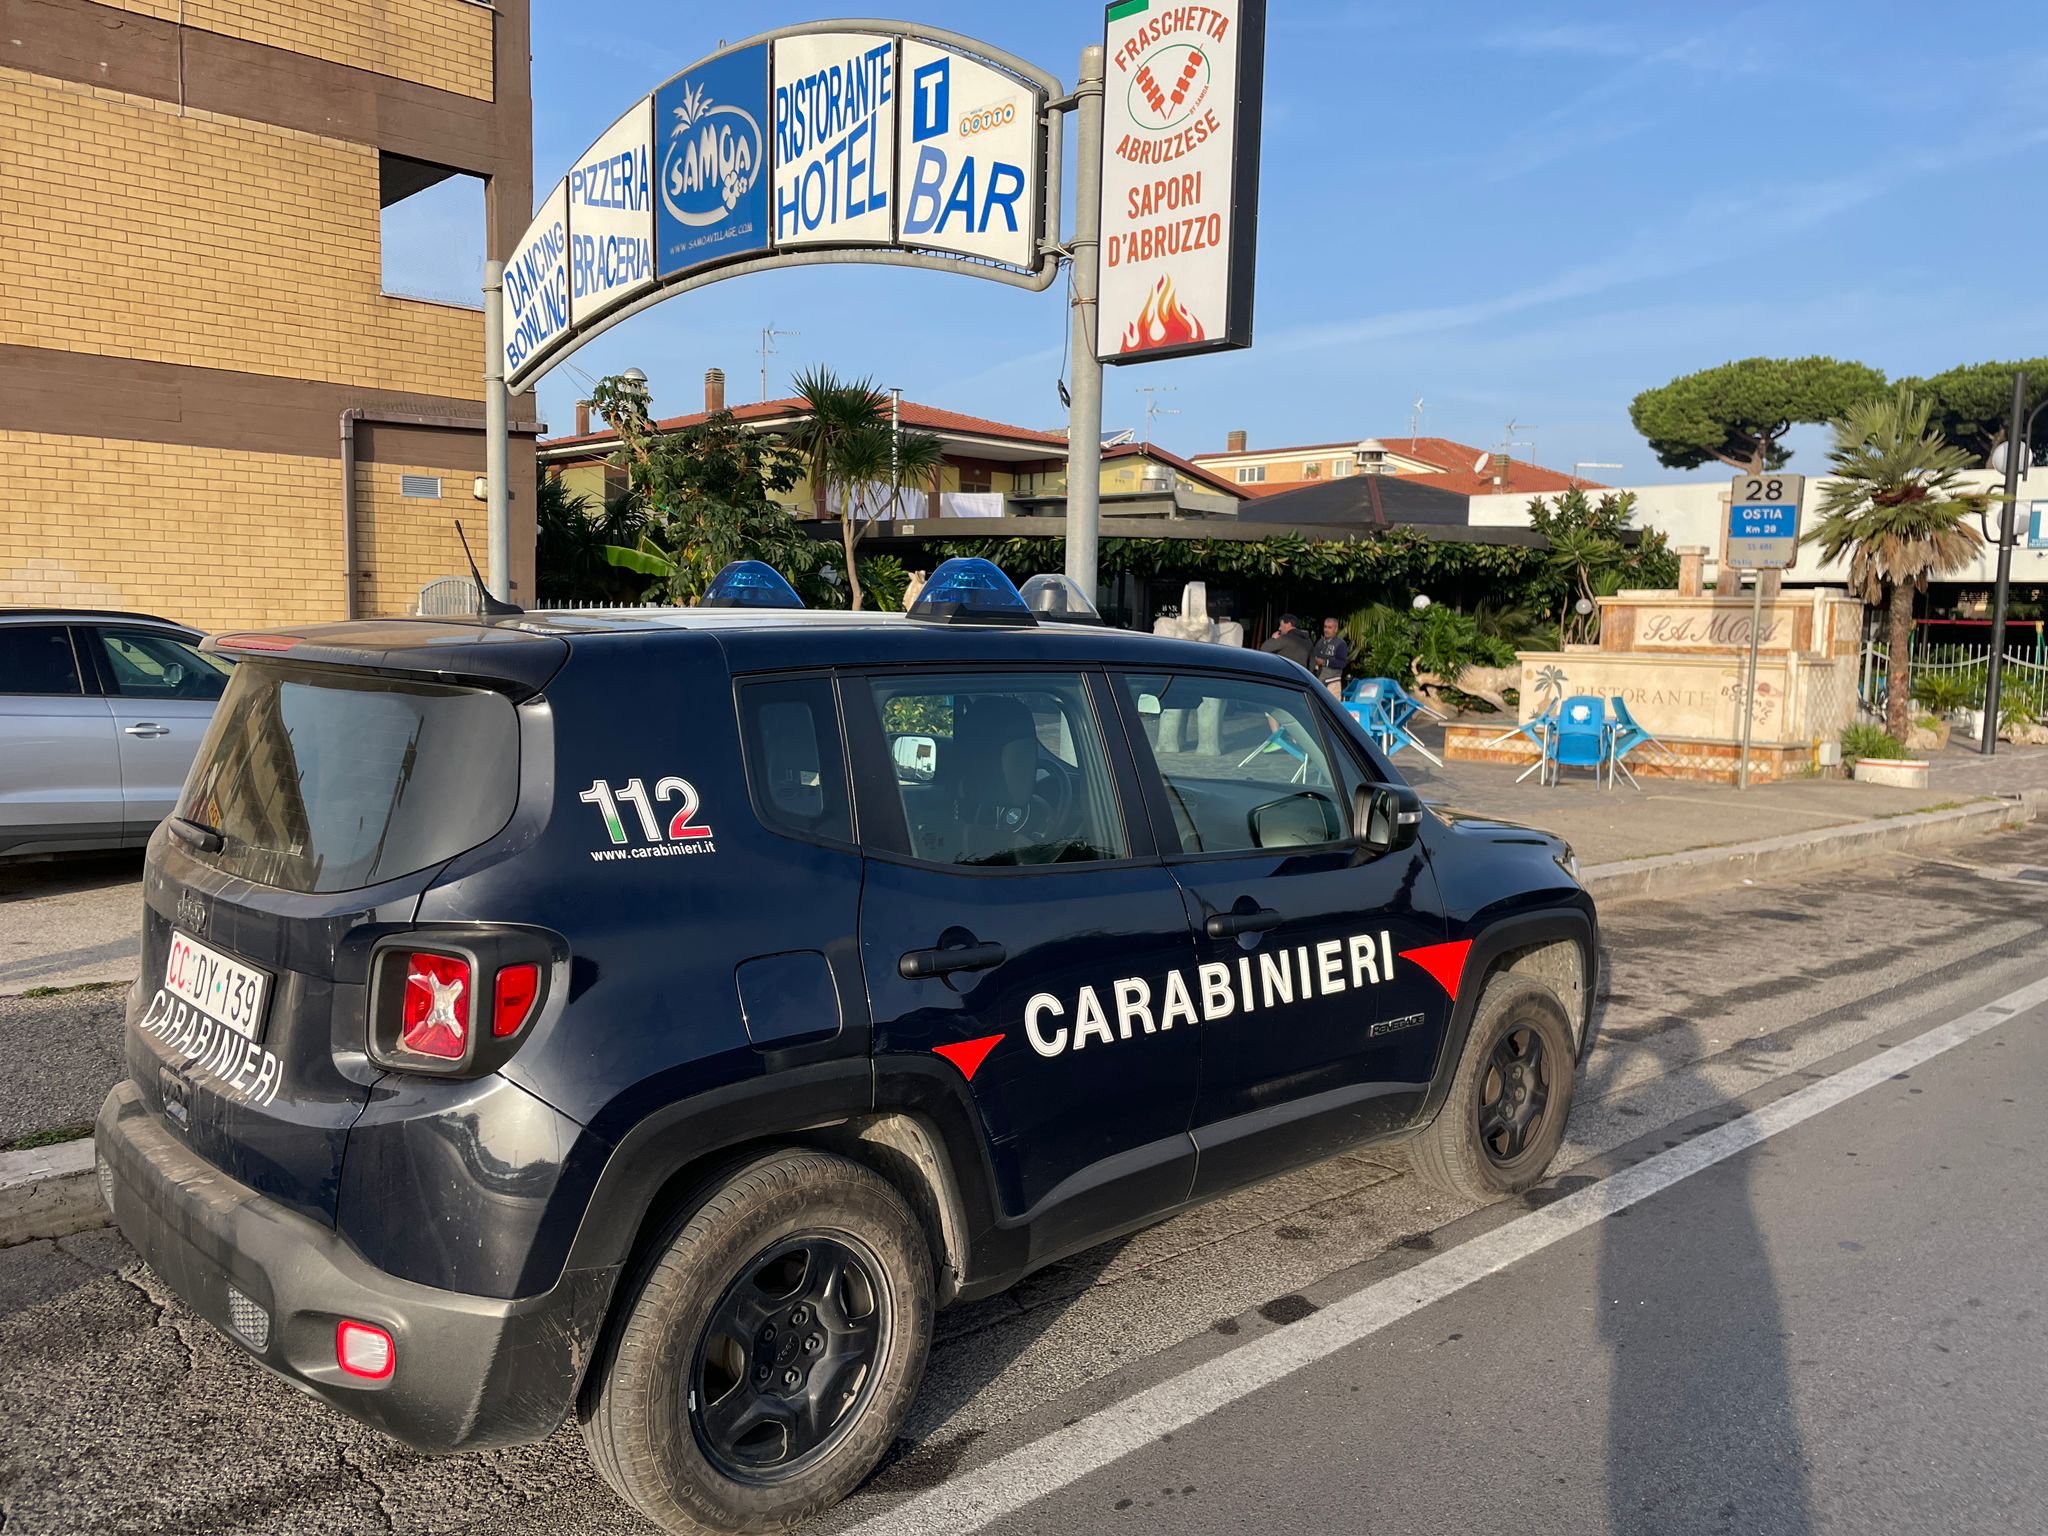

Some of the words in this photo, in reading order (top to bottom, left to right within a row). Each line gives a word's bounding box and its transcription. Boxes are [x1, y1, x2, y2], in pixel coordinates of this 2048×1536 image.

[1114, 6, 1230, 72] FRASCHETTA
[776, 42, 892, 169] RISTORANTE
[920, 70, 943, 129] T
[960, 104, 1015, 137] LOTTO
[1195, 85, 1209, 107] SAMOA
[670, 123, 749, 196] SAMOA
[1115, 108, 1221, 164] ABRUZZESE
[571, 144, 650, 212] PIZZERIA
[777, 110, 887, 240] HOTEL
[903, 144, 1025, 235] BAR
[1127, 171, 1202, 219] SAPORI
[504, 221, 565, 319] DANCING
[572, 234, 652, 299] BRACERIA
[1108, 213, 1221, 267] D'ABRUZZO
[506, 265, 567, 370] BOWLING
[1742, 508, 1783, 520] OSTIA
[1746, 480, 1783, 501] 28
[1643, 613, 1785, 643] SAMOA
[579, 776, 713, 844] 112
[590, 841, 716, 861] www.carabinieri.it
[169, 941, 190, 990] CC
[194, 953, 219, 1006] DY
[221, 968, 256, 1027] 139
[1024, 929, 1396, 1058] CARABINIERI
[140, 989, 284, 1108] CARABINIERI
